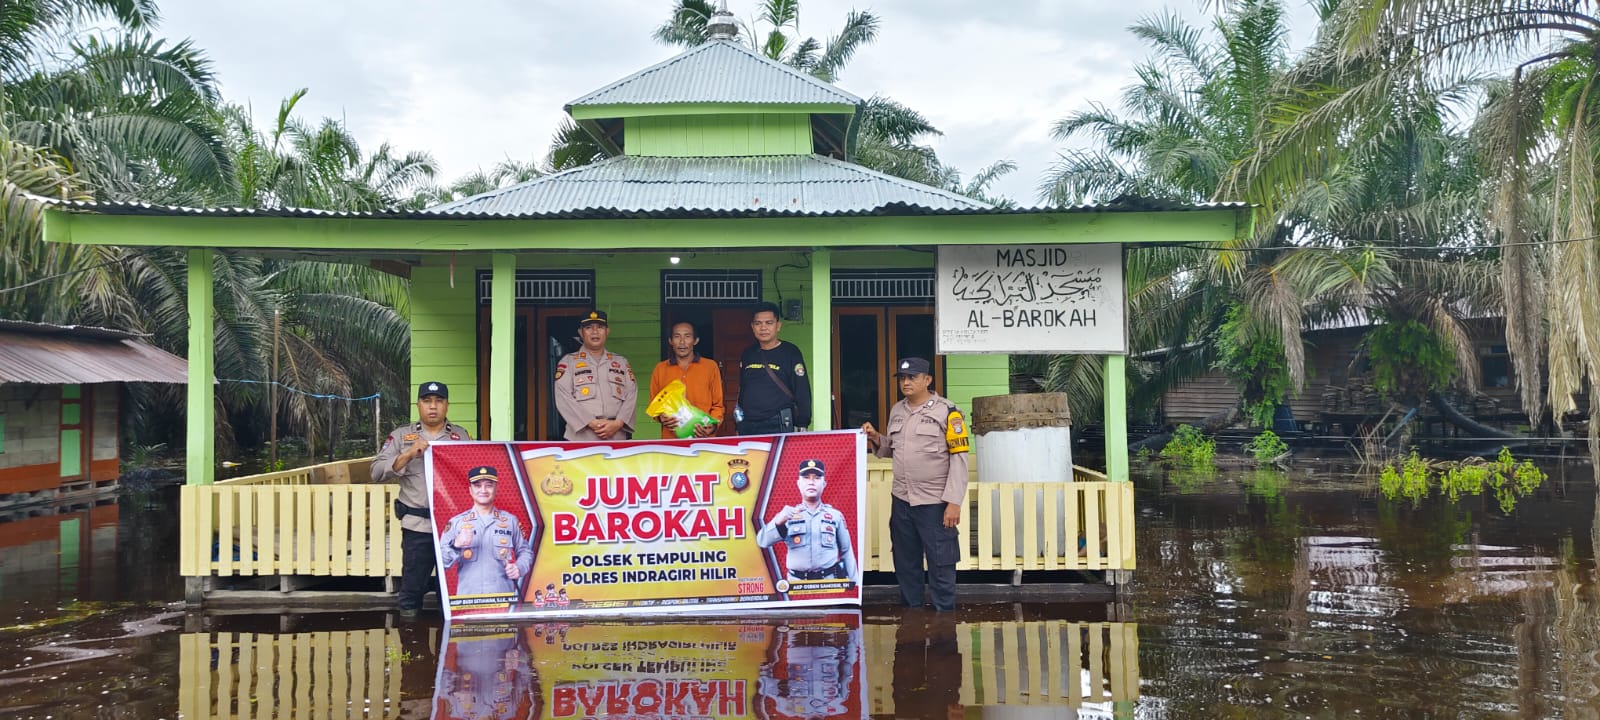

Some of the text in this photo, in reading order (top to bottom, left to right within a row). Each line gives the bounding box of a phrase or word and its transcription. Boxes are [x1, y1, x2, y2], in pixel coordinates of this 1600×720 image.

[996, 248, 1067, 268] MASJID
[577, 474, 720, 508] JUM'AT
[552, 507, 745, 543] BAROKAH
[571, 551, 727, 568] POLSEK TEMPULING
[562, 567, 737, 585] POLRES INDRAGIRI HILIR
[737, 583, 764, 594] STRONG
